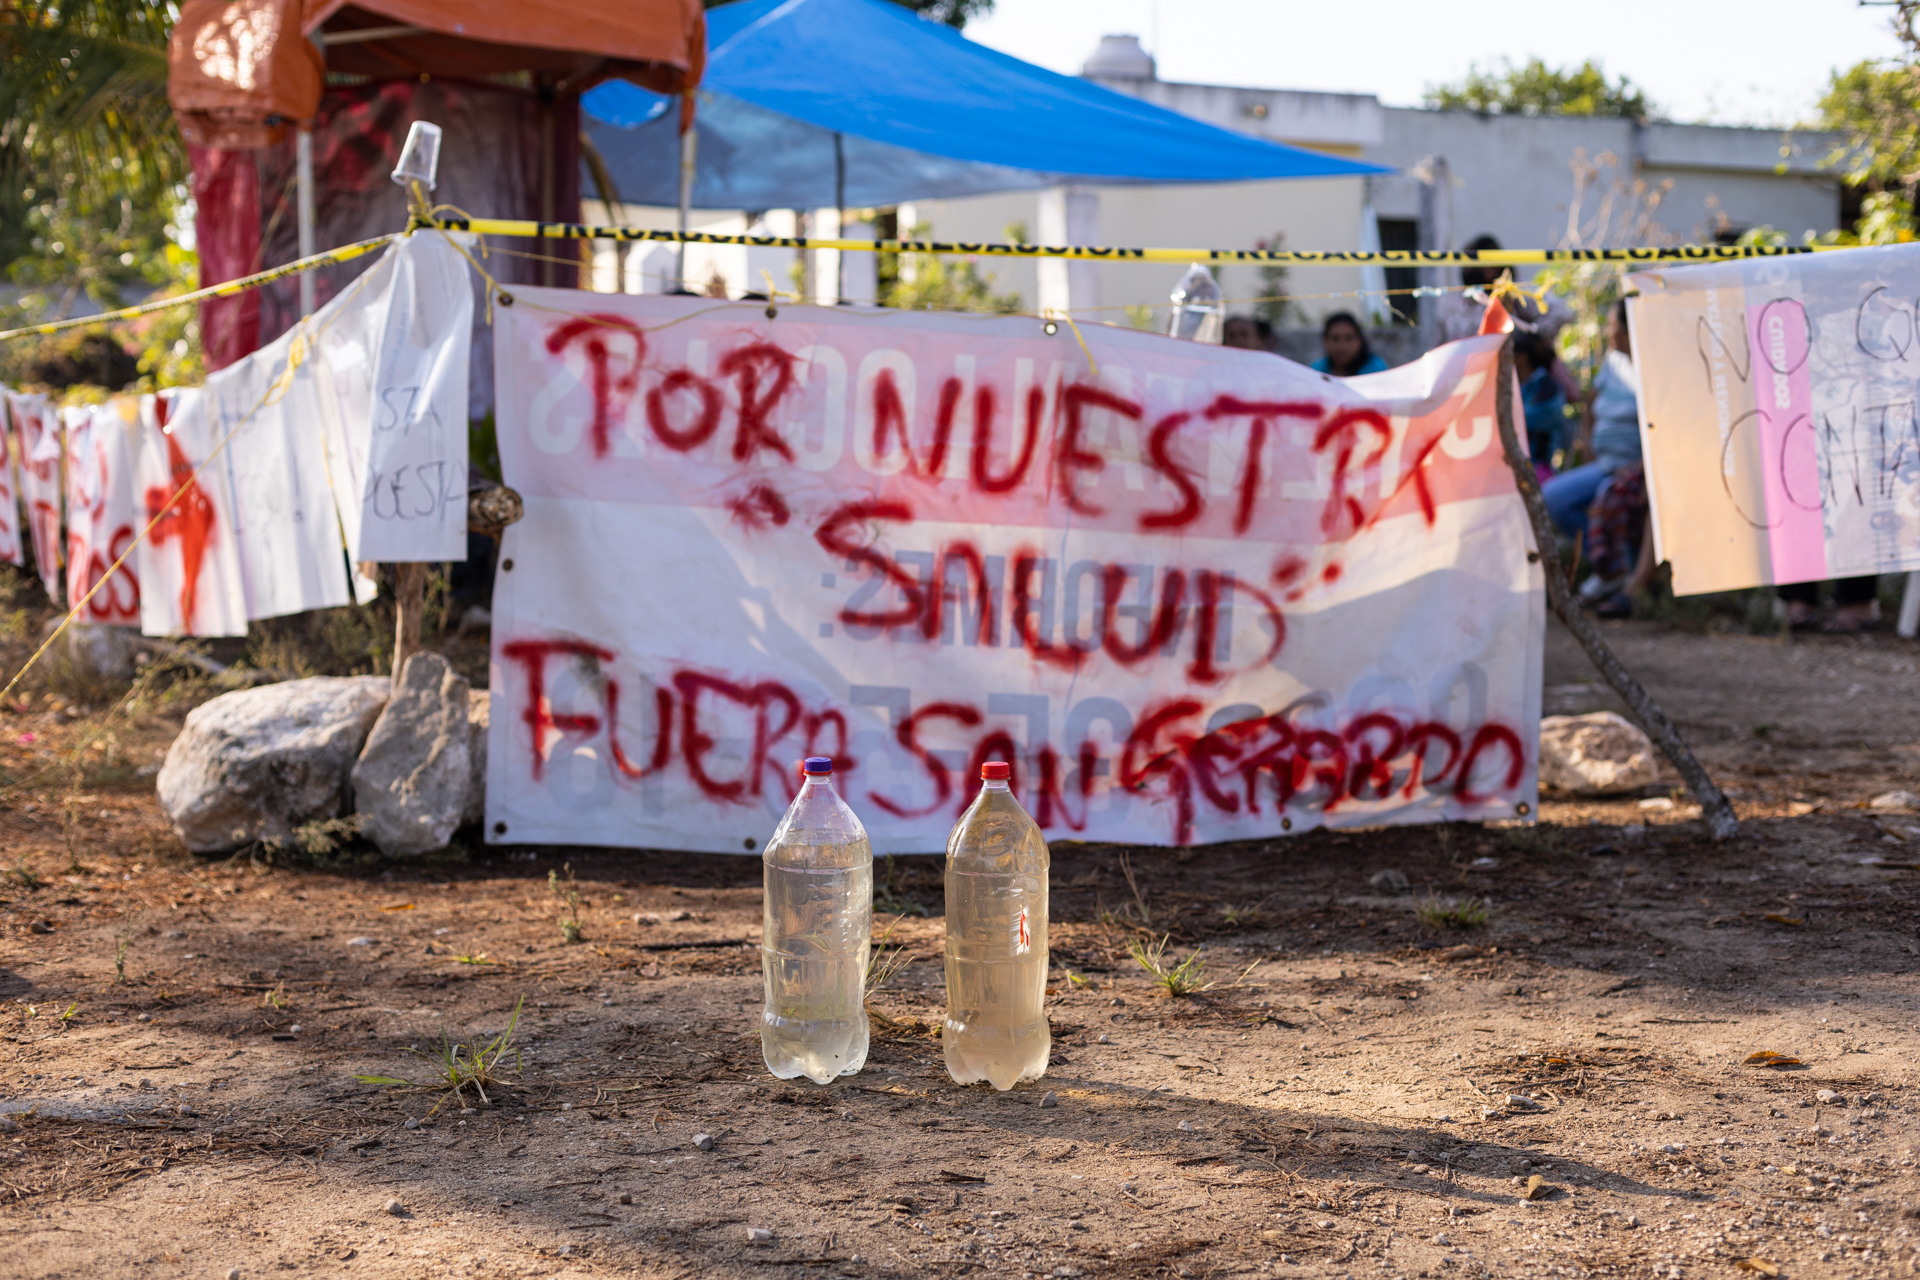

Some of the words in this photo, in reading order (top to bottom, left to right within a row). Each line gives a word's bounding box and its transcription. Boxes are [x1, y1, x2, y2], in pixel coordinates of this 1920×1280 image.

[544, 311, 799, 463] POR
[1696, 296, 1813, 394] NO
[502, 640, 859, 803] FUERA
[868, 701, 1098, 833] SAN
